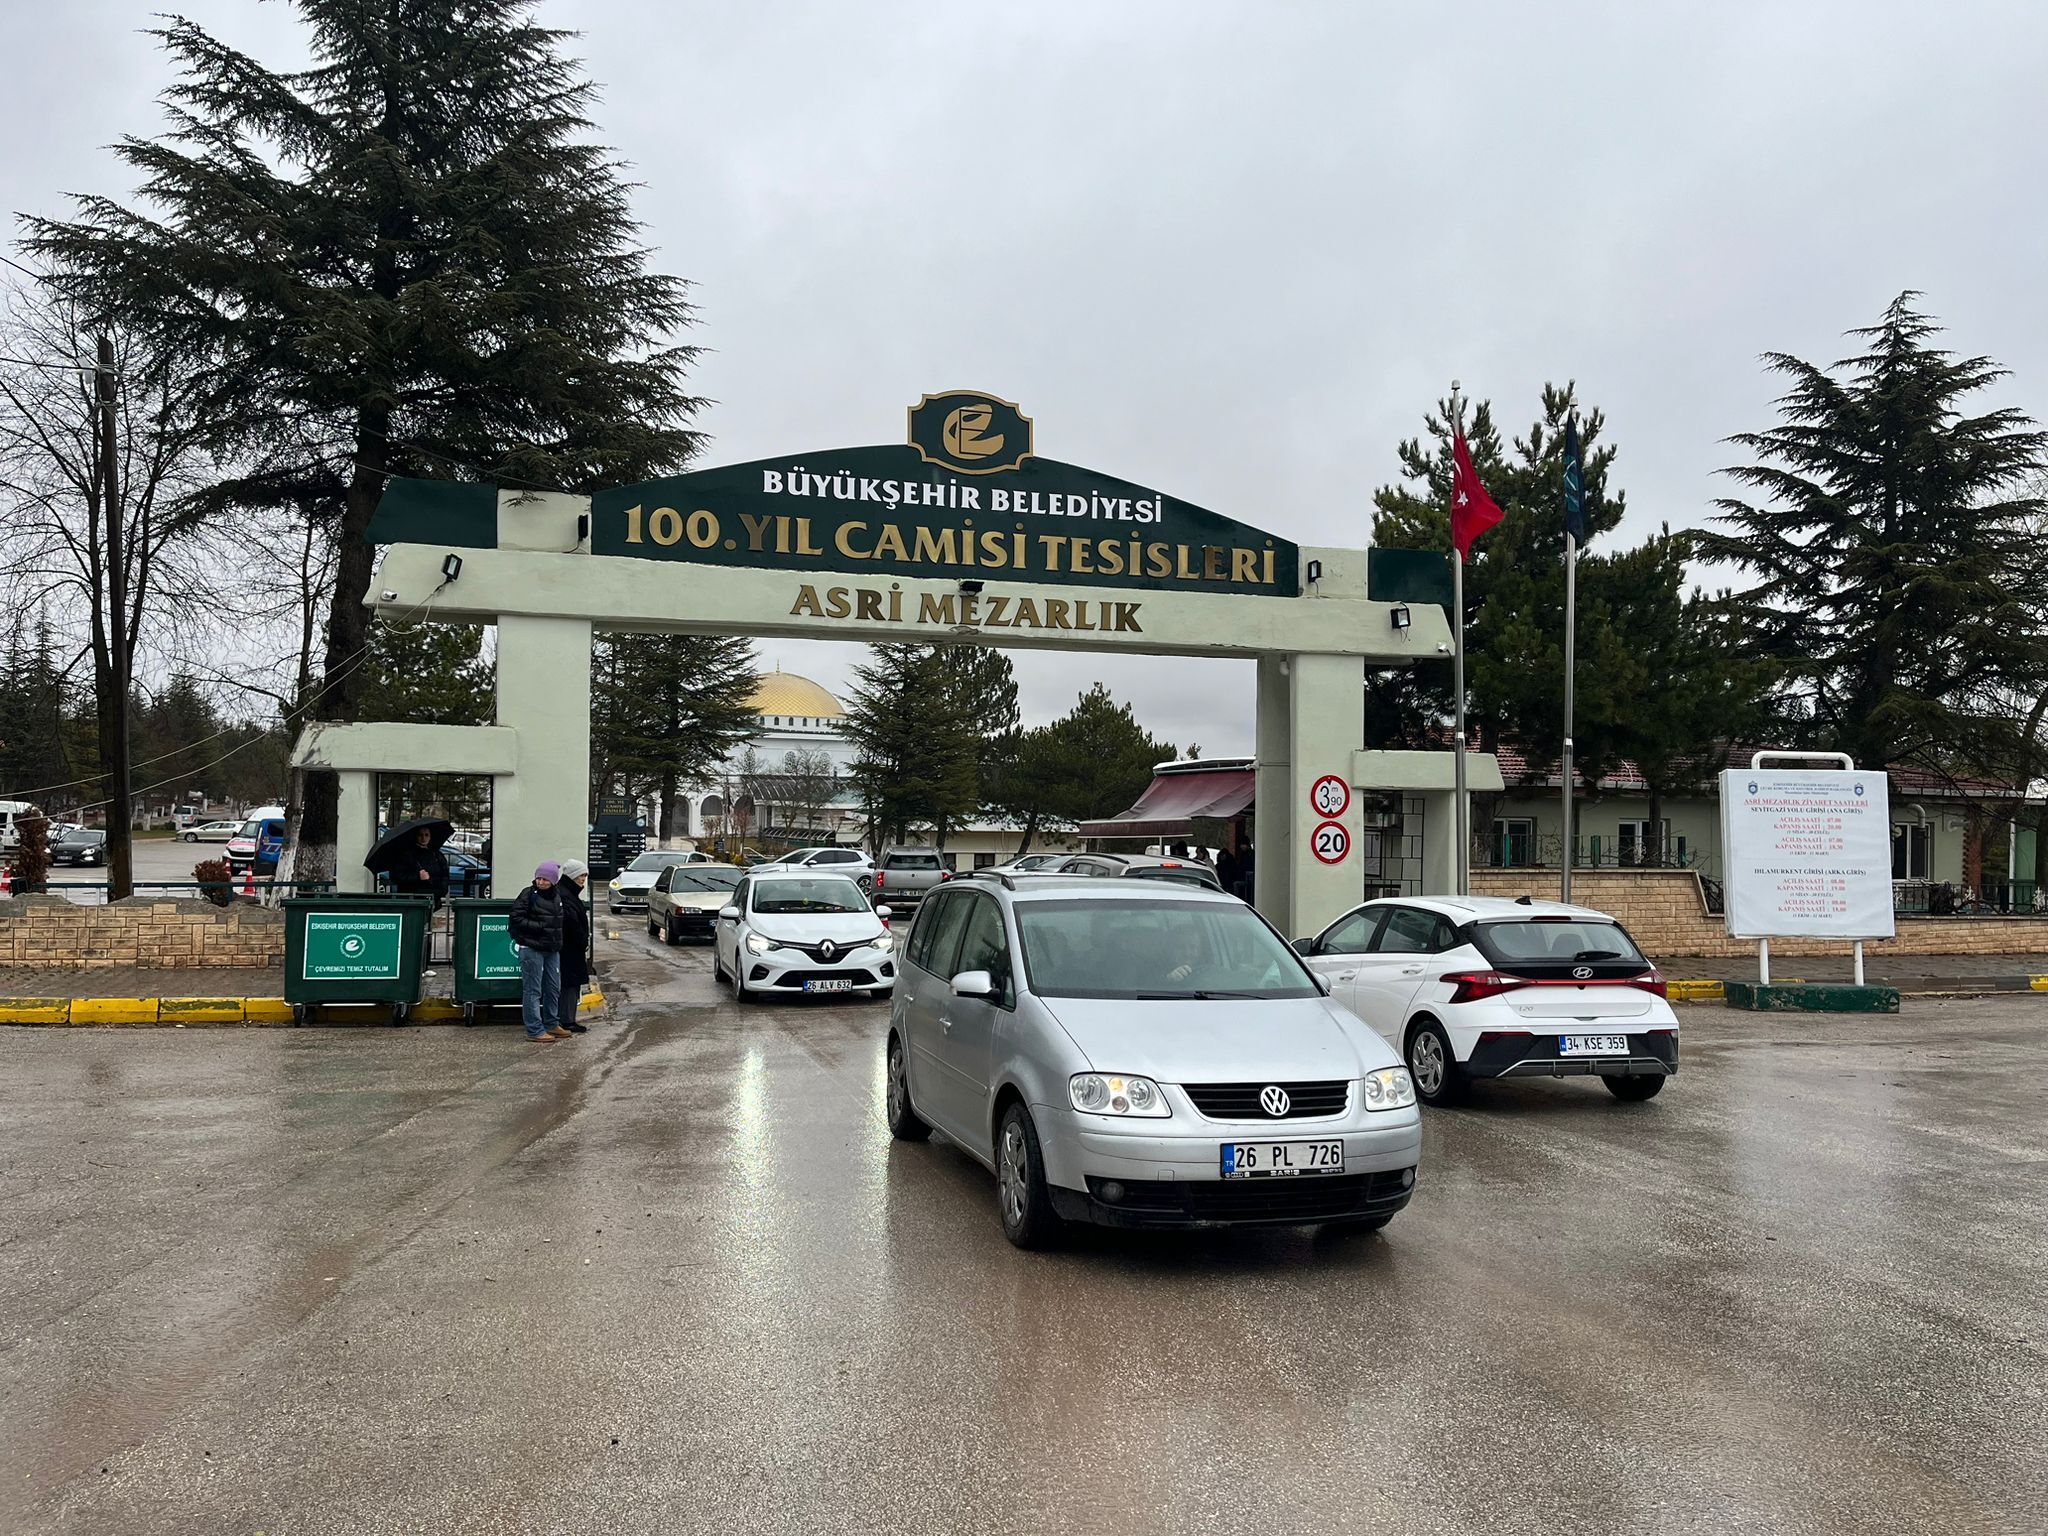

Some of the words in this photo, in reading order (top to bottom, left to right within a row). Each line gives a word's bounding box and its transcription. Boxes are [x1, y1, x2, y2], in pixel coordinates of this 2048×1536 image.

[762, 465, 981, 510] BÜYÜKŞEHİR
[991, 488, 1162, 523] BELEDİYESİ
[834, 518, 1027, 569] CAMİSİ
[1038, 530, 1275, 584] TESİSLERİ
[789, 582, 903, 622] ASRİ
[917, 591, 1144, 632] MEZARLIK
[1331, 796, 1343, 806] 90
[1318, 833, 1345, 853] 20
[820, 981, 835, 990] ALV
[837, 980, 850, 989] 632
[1566, 1038, 1579, 1050] 34
[1584, 1037, 1603, 1050] KSE
[1606, 1036, 1625, 1050] 359
[1236, 1147, 1256, 1168] 26
[1272, 1146, 1293, 1167] PL
[1308, 1144, 1340, 1166] 726
